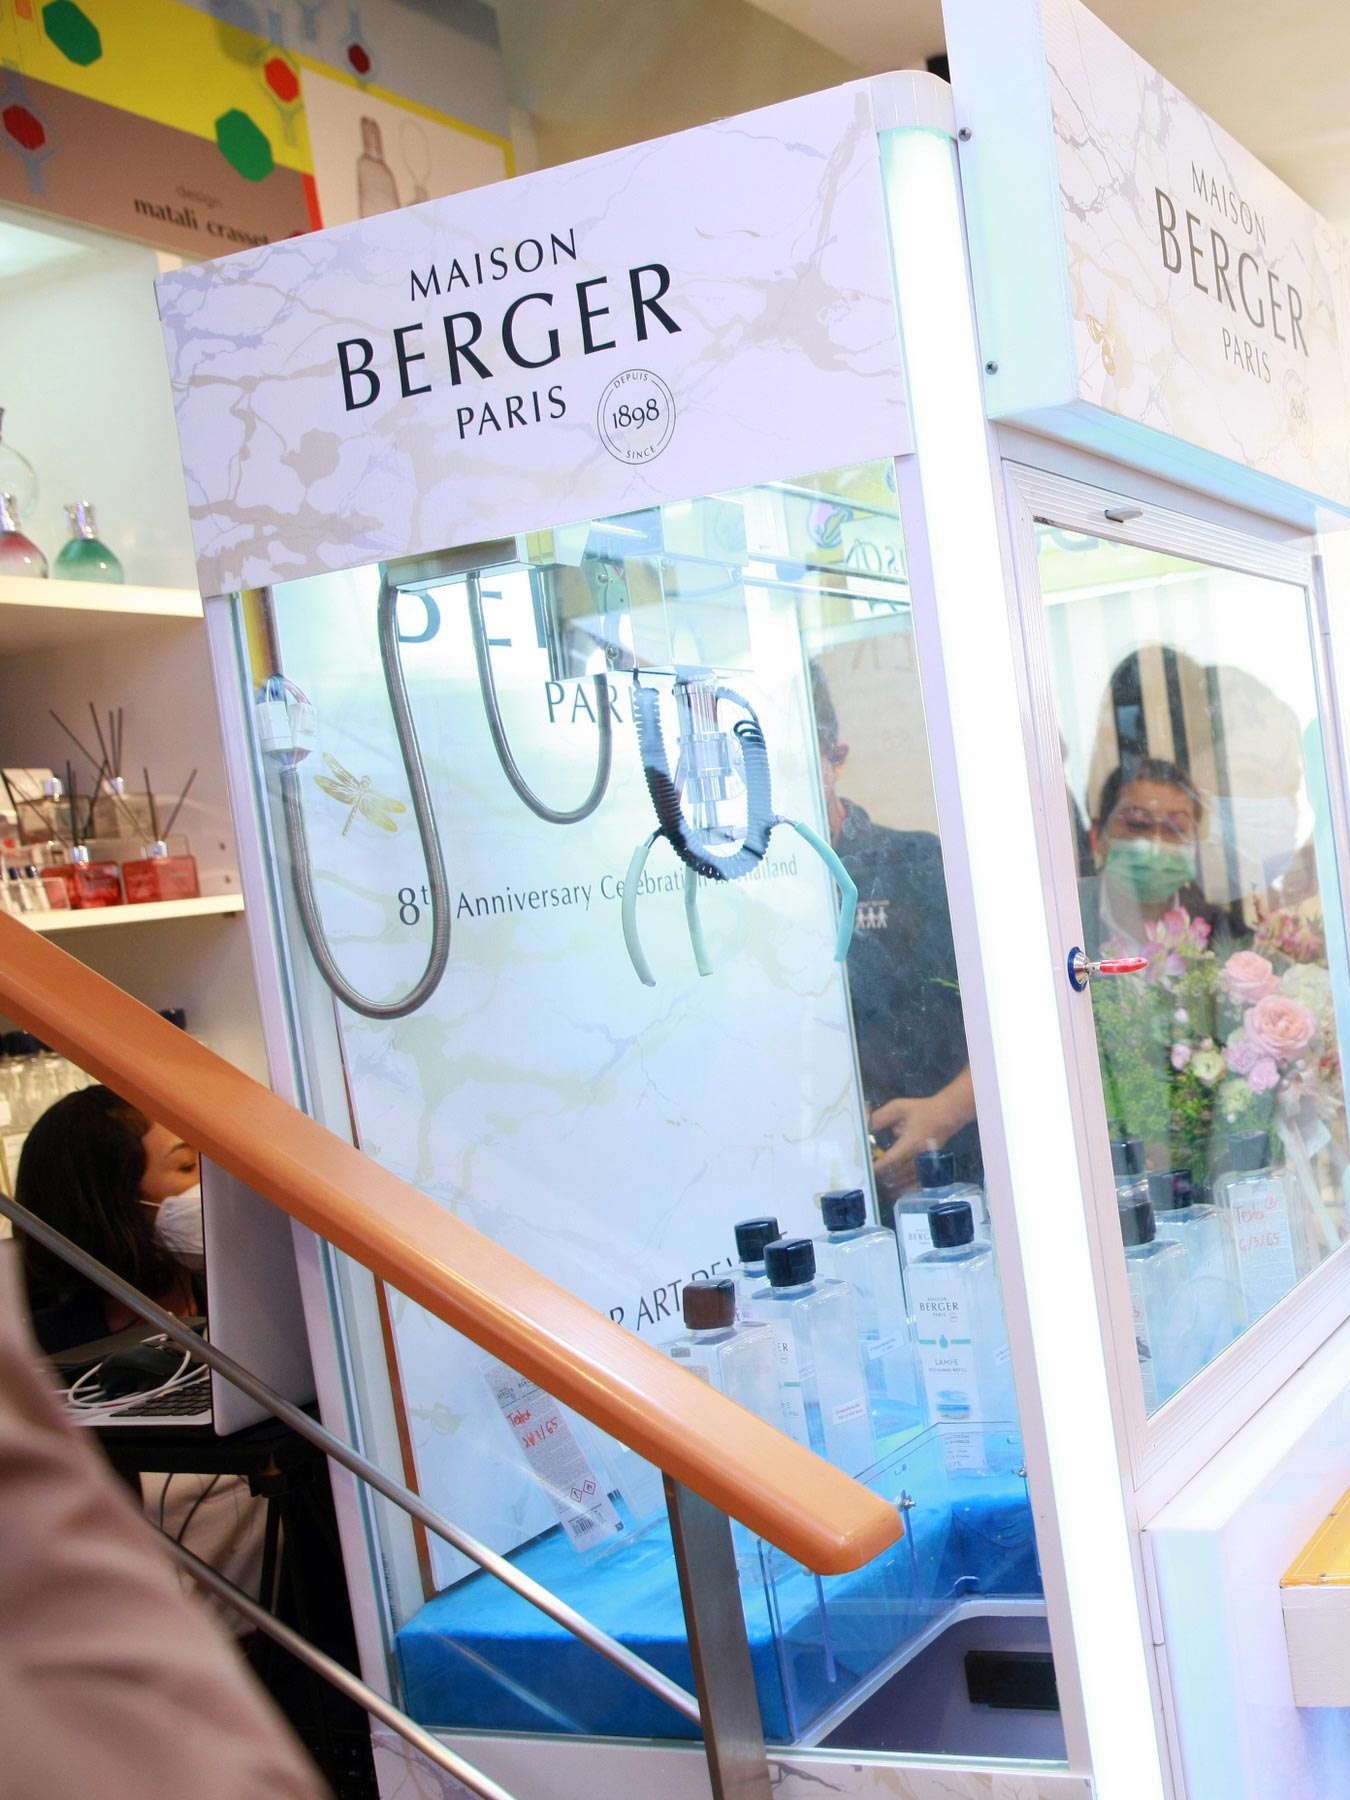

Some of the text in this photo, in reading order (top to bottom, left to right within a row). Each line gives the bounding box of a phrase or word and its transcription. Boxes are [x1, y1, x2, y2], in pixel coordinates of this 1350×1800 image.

[133, 198, 198, 230] matali
[1191, 159, 1267, 246] MAISON
[409, 228, 578, 301] MAISON
[1154, 186, 1309, 358] BERGER
[336, 263, 682, 411] BERGER
[1221, 326, 1273, 385] PARIS
[613, 372, 649, 389] DEPUIS
[456, 385, 567, 440] PARIS
[612, 398, 660, 430] 1898
[626, 443, 656, 460] SINCE
[397, 884, 432, 926] 8t
[455, 883, 592, 920] Anniversary
[600, 866, 709, 900] Ceebratin
[908, 1232, 931, 1241] BERG
[636, 1279, 683, 1332] ART
[919, 1302, 959, 1312] BERGER
